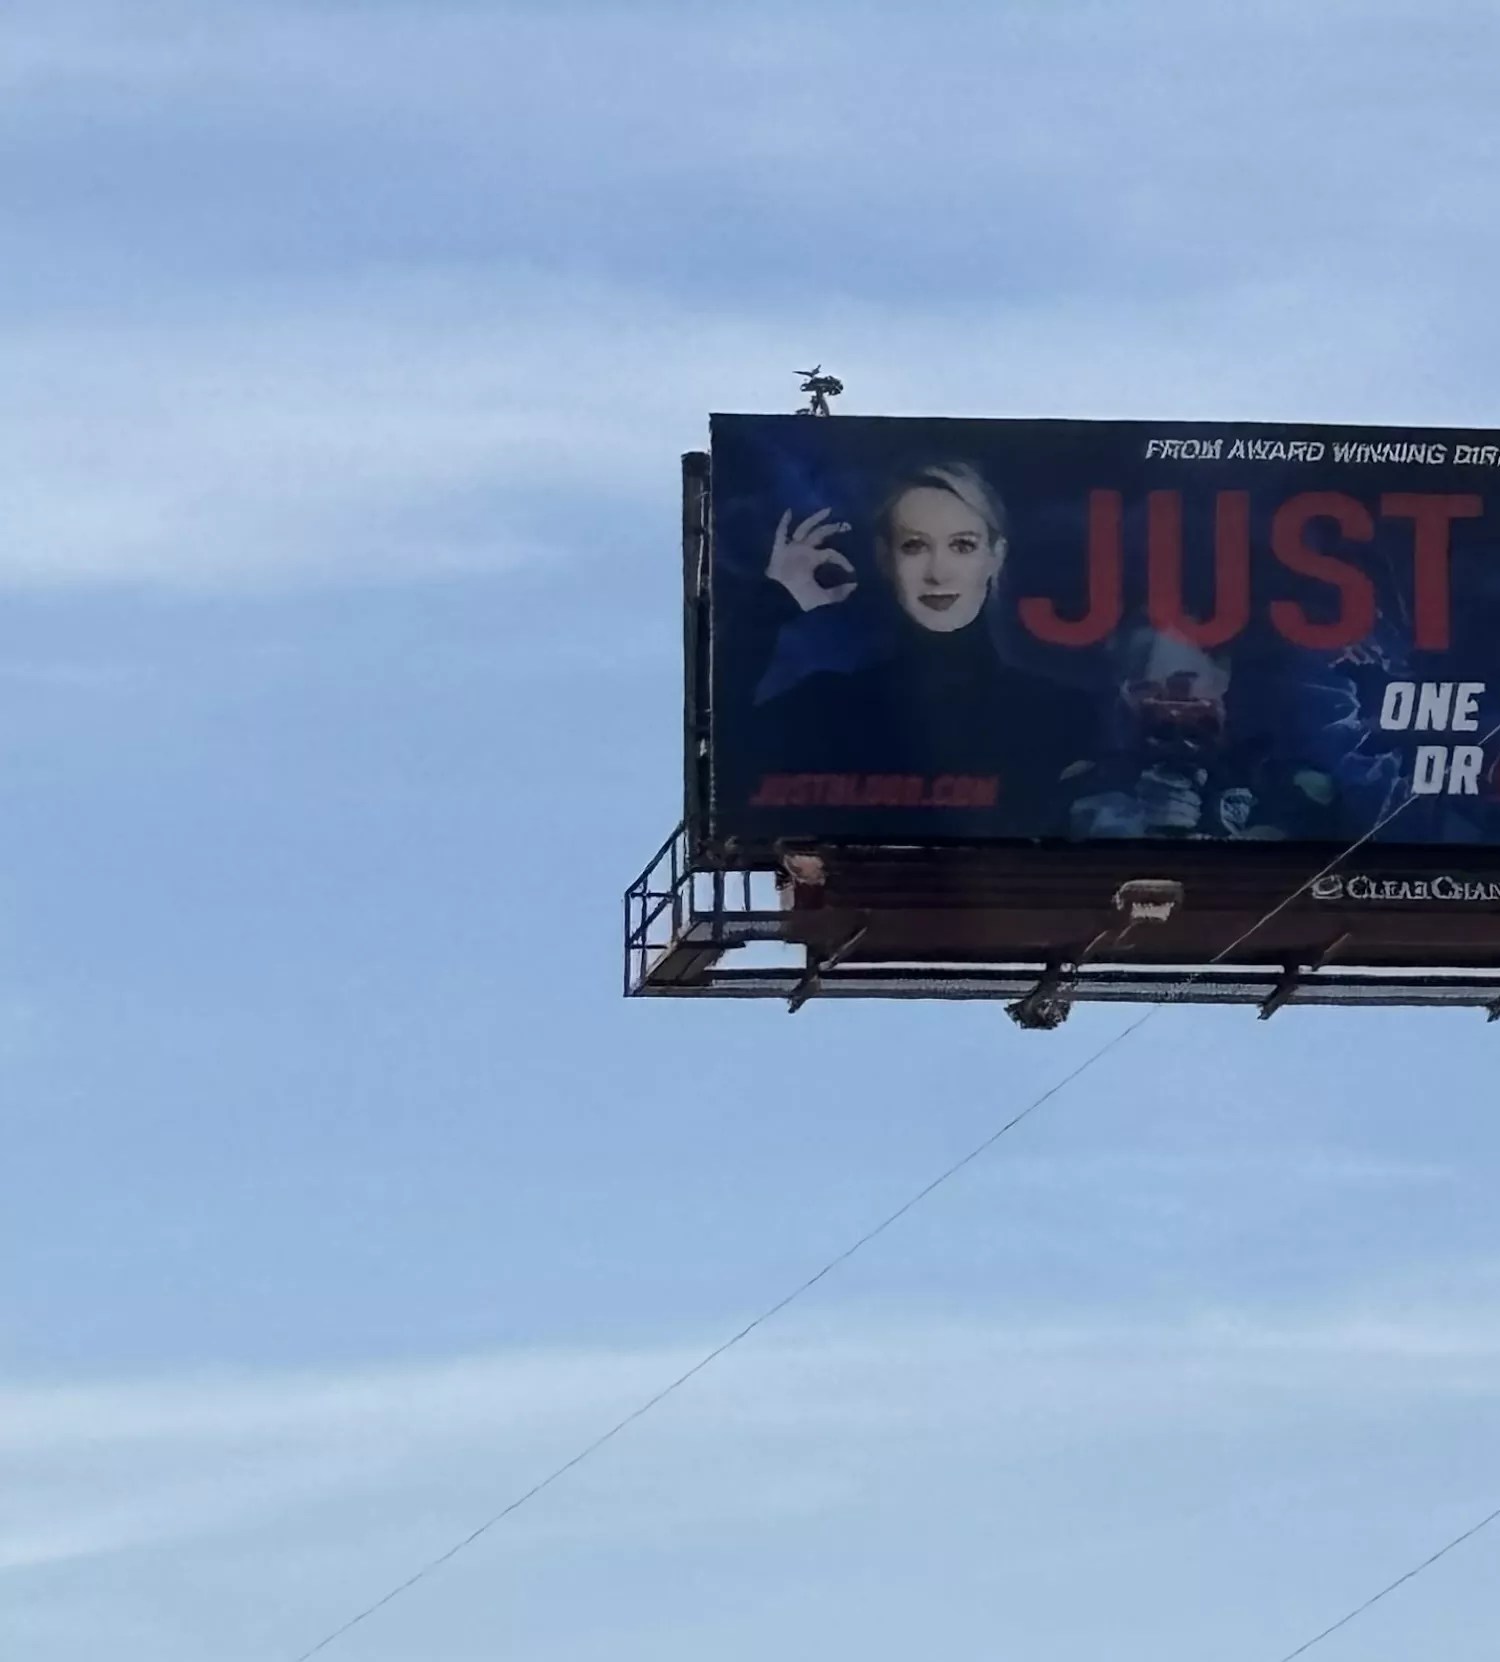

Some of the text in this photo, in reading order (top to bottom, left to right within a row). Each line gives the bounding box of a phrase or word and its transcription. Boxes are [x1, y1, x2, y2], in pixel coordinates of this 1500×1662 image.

[1145, 438, 1221, 460] FROM
[1227, 439, 1325, 462] AWARD
[1333, 442, 1447, 464] WINNING
[1018, 489, 1484, 650] JUST
[1380, 681, 1486, 731] ONE
